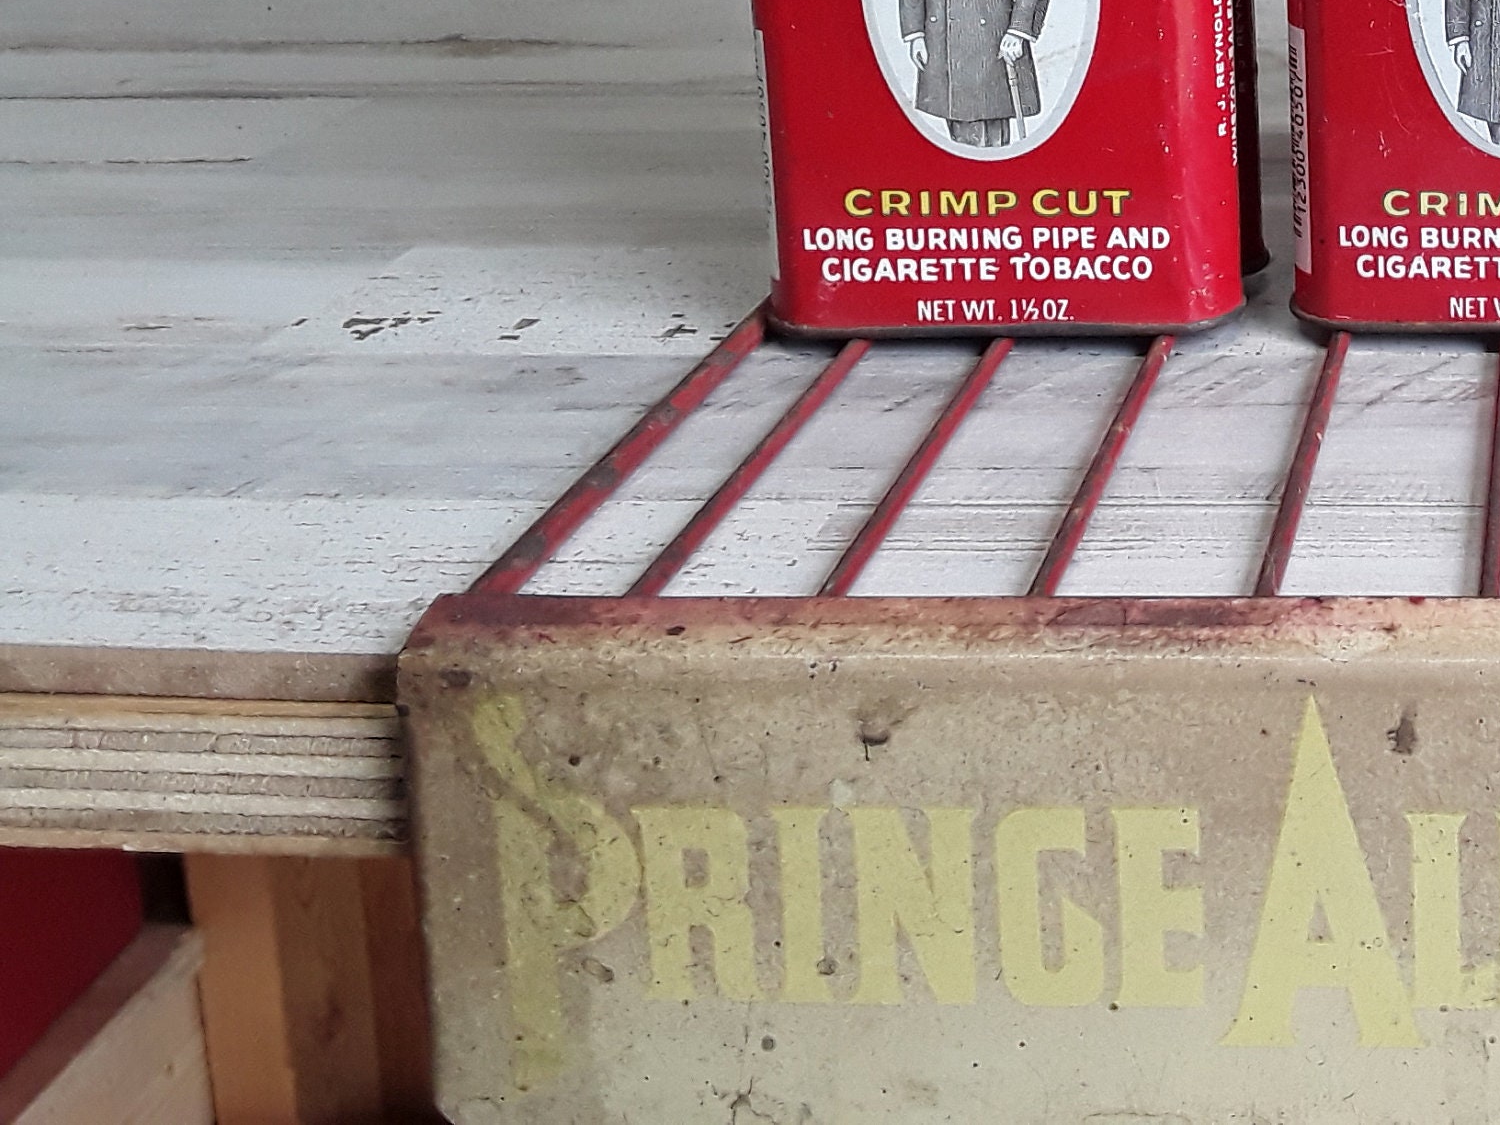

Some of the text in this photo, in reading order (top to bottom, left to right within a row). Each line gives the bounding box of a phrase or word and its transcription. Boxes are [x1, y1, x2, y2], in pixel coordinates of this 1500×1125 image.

[843, 188, 1131, 217] CRIMP CUT
[802, 227, 1170, 251] LONG BURNING PIPE AND
[1339, 226, 1408, 248] LONG
[822, 252, 1153, 282] CIGARETTE TOBACCO
[917, 299, 955, 321] NET
[961, 299, 1002, 321] WT.
[1043, 299, 1074, 321] OZ.
[1450, 297, 1488, 319] NET
[473, 694, 1203, 1092] PRINCE
